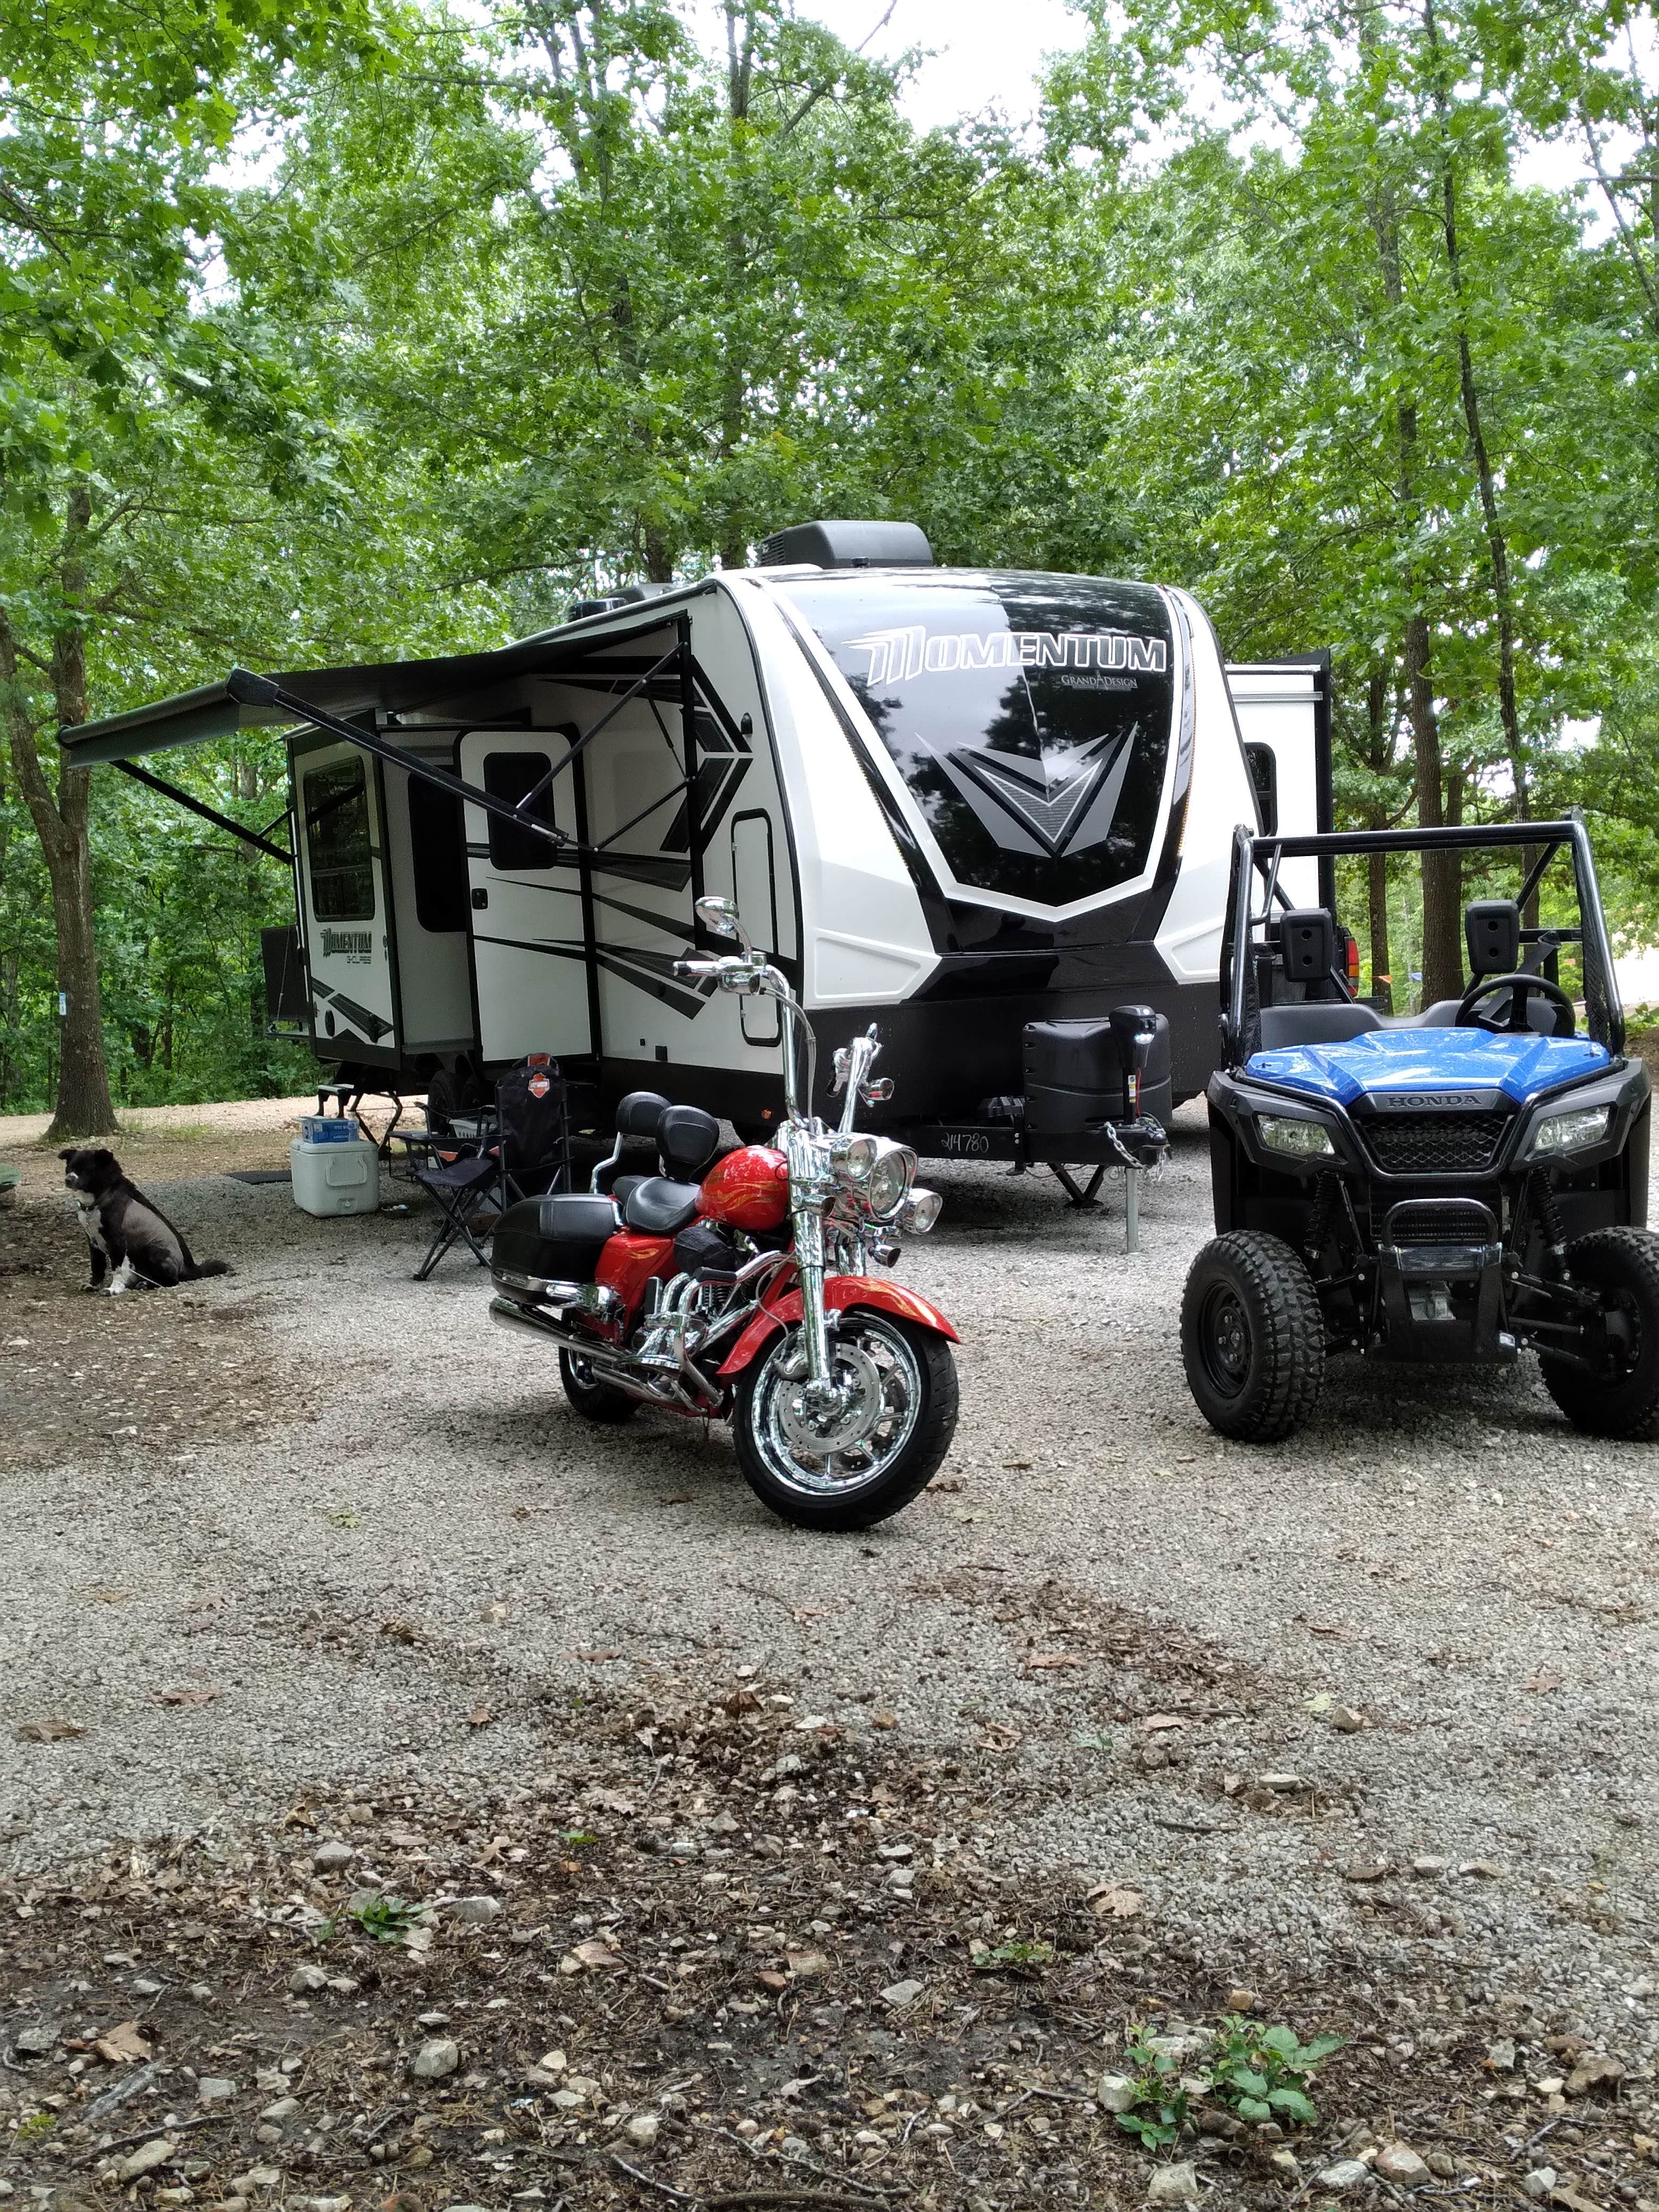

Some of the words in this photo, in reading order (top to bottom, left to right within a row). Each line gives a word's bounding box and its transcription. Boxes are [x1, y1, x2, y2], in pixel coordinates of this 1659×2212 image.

[841, 625, 1166, 687] MOMENTUM
[320, 928, 372, 957] MOMENTUM
[1387, 1095, 1482, 1107] HONDA
[941, 1132, 989, 1153] 214780
